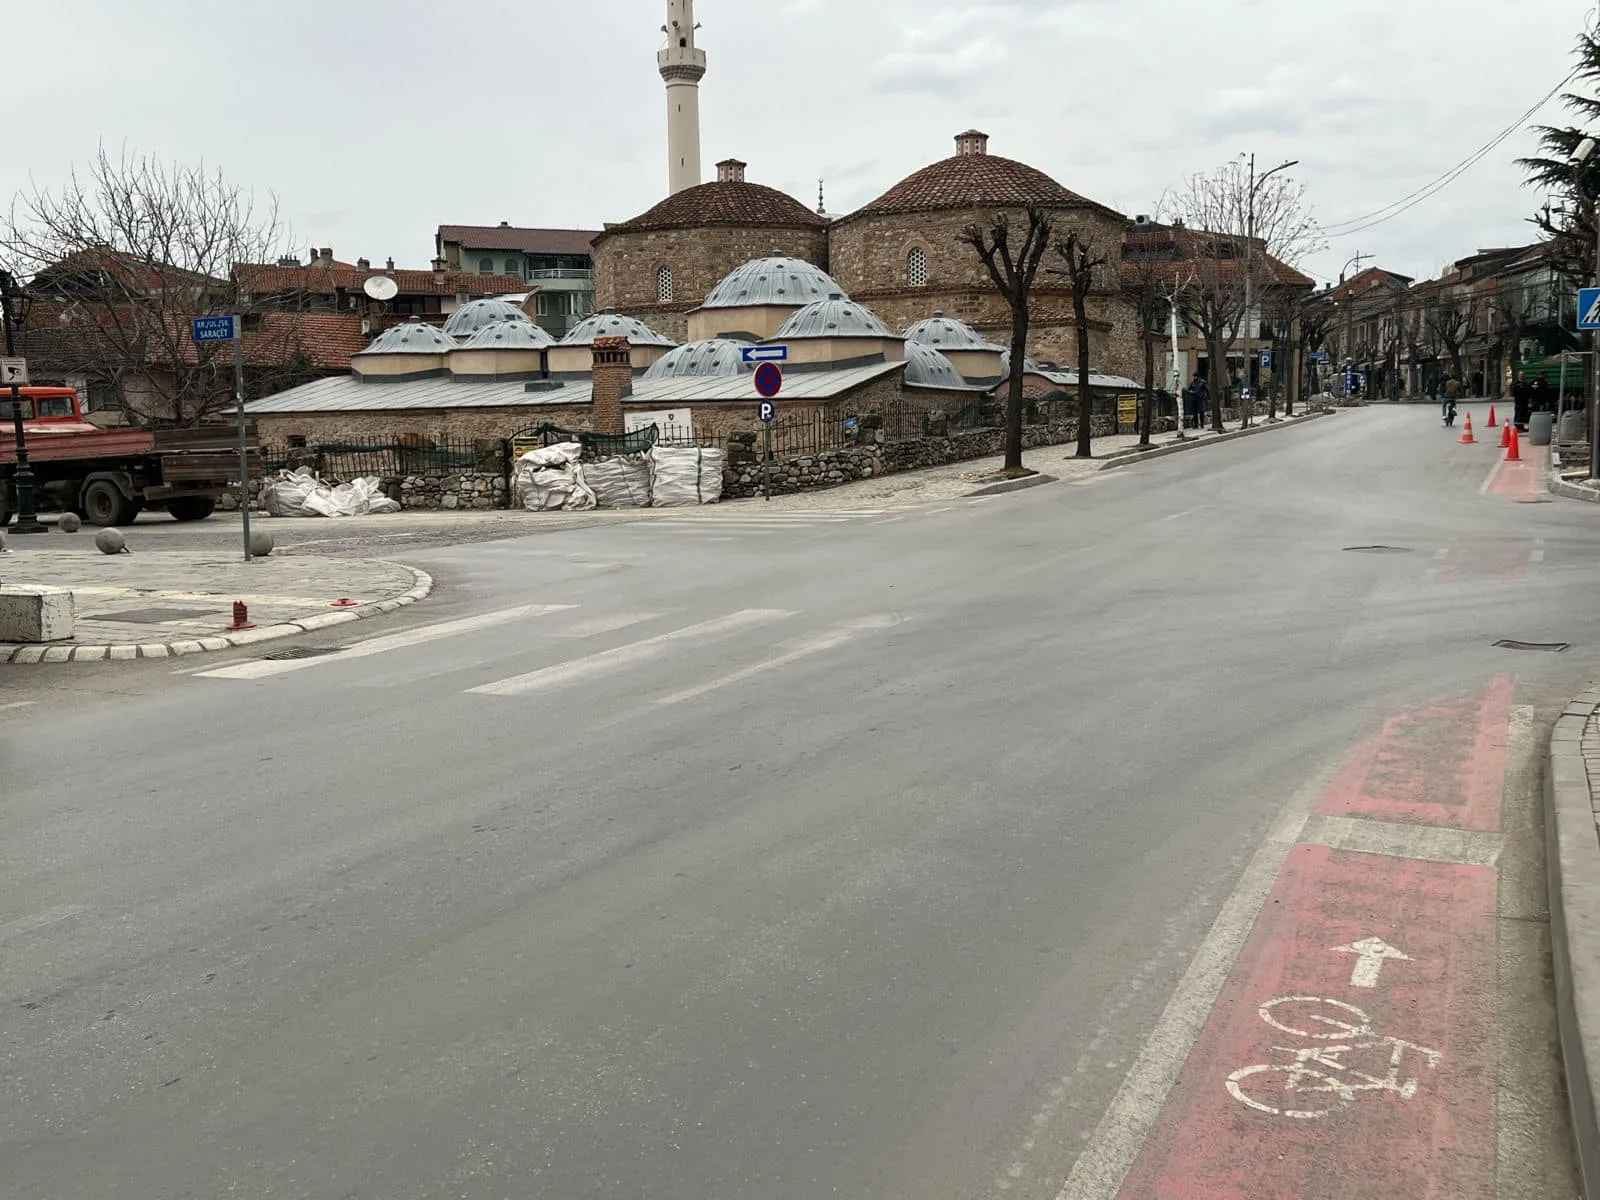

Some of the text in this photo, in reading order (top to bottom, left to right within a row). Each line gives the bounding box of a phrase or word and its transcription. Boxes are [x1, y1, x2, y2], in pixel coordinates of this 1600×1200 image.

[199, 328, 228, 339] SARAÇËT
[1261, 355, 1269, 367] P
[761, 403, 772, 420] P
